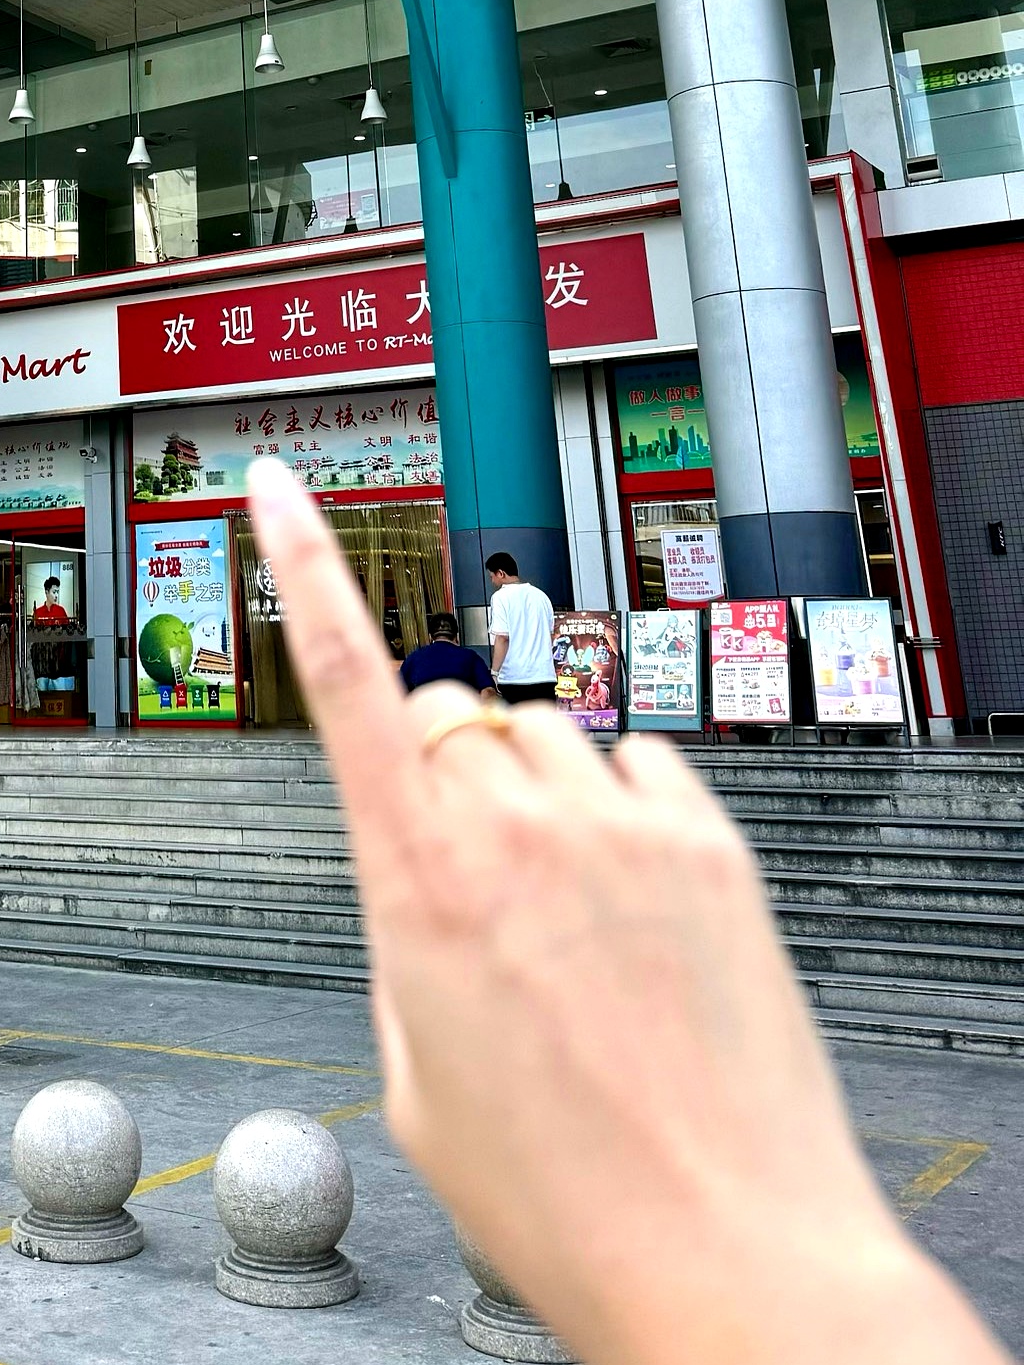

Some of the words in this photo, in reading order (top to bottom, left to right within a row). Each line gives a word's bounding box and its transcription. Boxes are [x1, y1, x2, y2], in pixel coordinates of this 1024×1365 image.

[269, 342, 347, 363] WELCOME
[355, 339, 378, 351] TO
[253, 443, 280, 456] 富强
[293, 440, 322, 453] 民主
[363, 436, 393, 449] 文明
[407, 432, 438, 445] 和谐
[148, 555, 212, 578] 垃圾分类
[163, 579, 224, 604] 举手之劳
